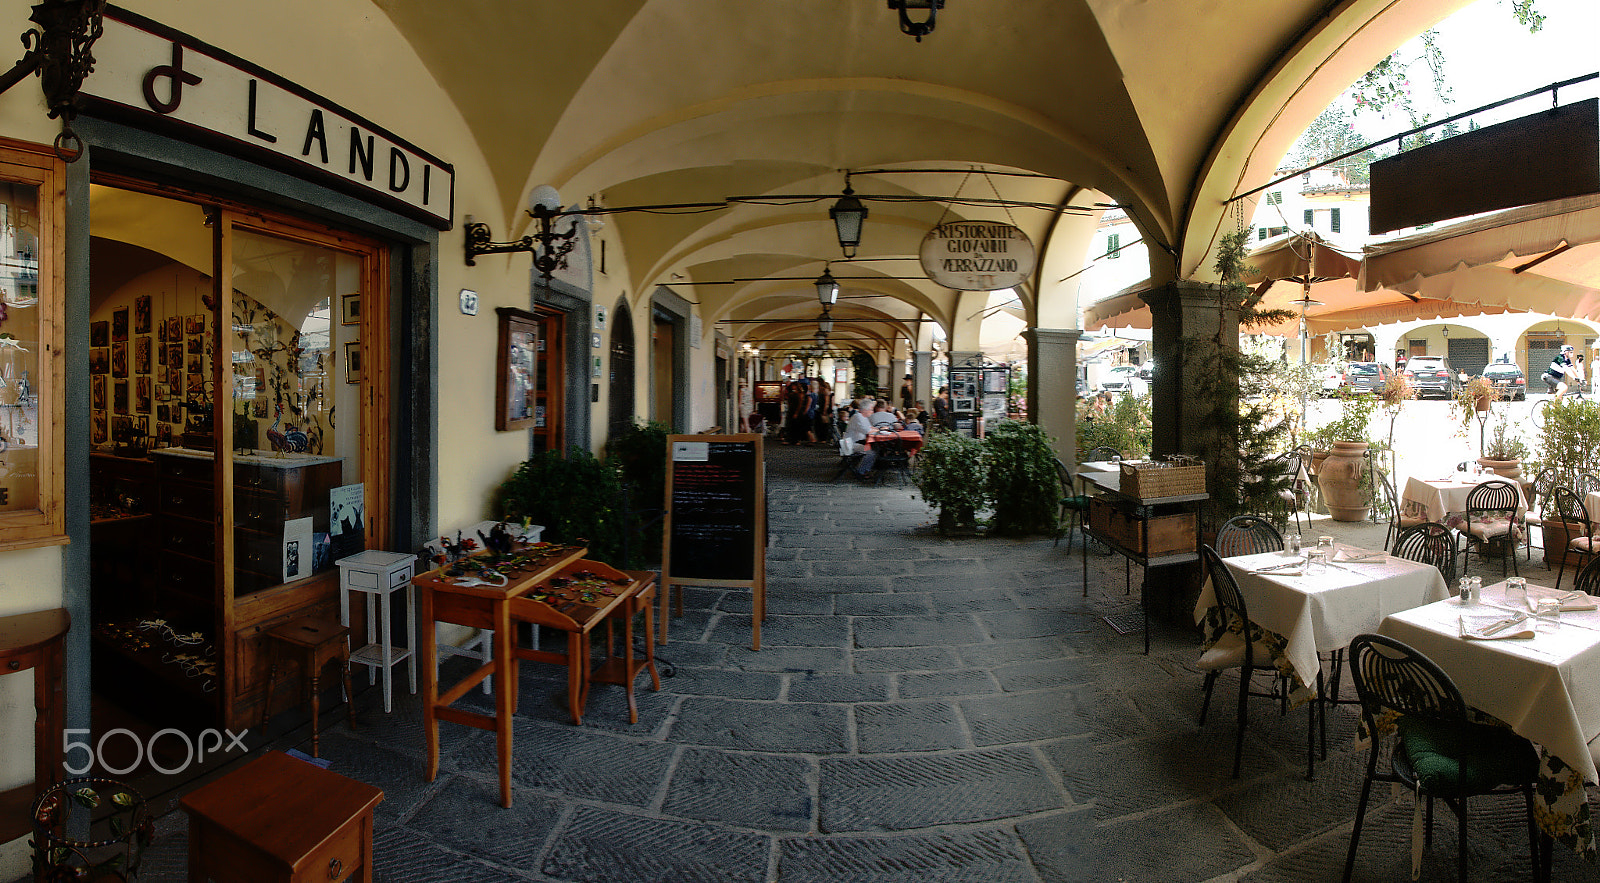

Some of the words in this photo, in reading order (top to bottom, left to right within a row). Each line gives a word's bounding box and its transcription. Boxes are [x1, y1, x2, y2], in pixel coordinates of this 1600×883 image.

[246, 79, 431, 207] LANDI
[938, 225, 1016, 238] RISTORANTE
[947, 239, 1008, 253] GIOVANNI
[942, 259, 1017, 272] VERRAZZANO
